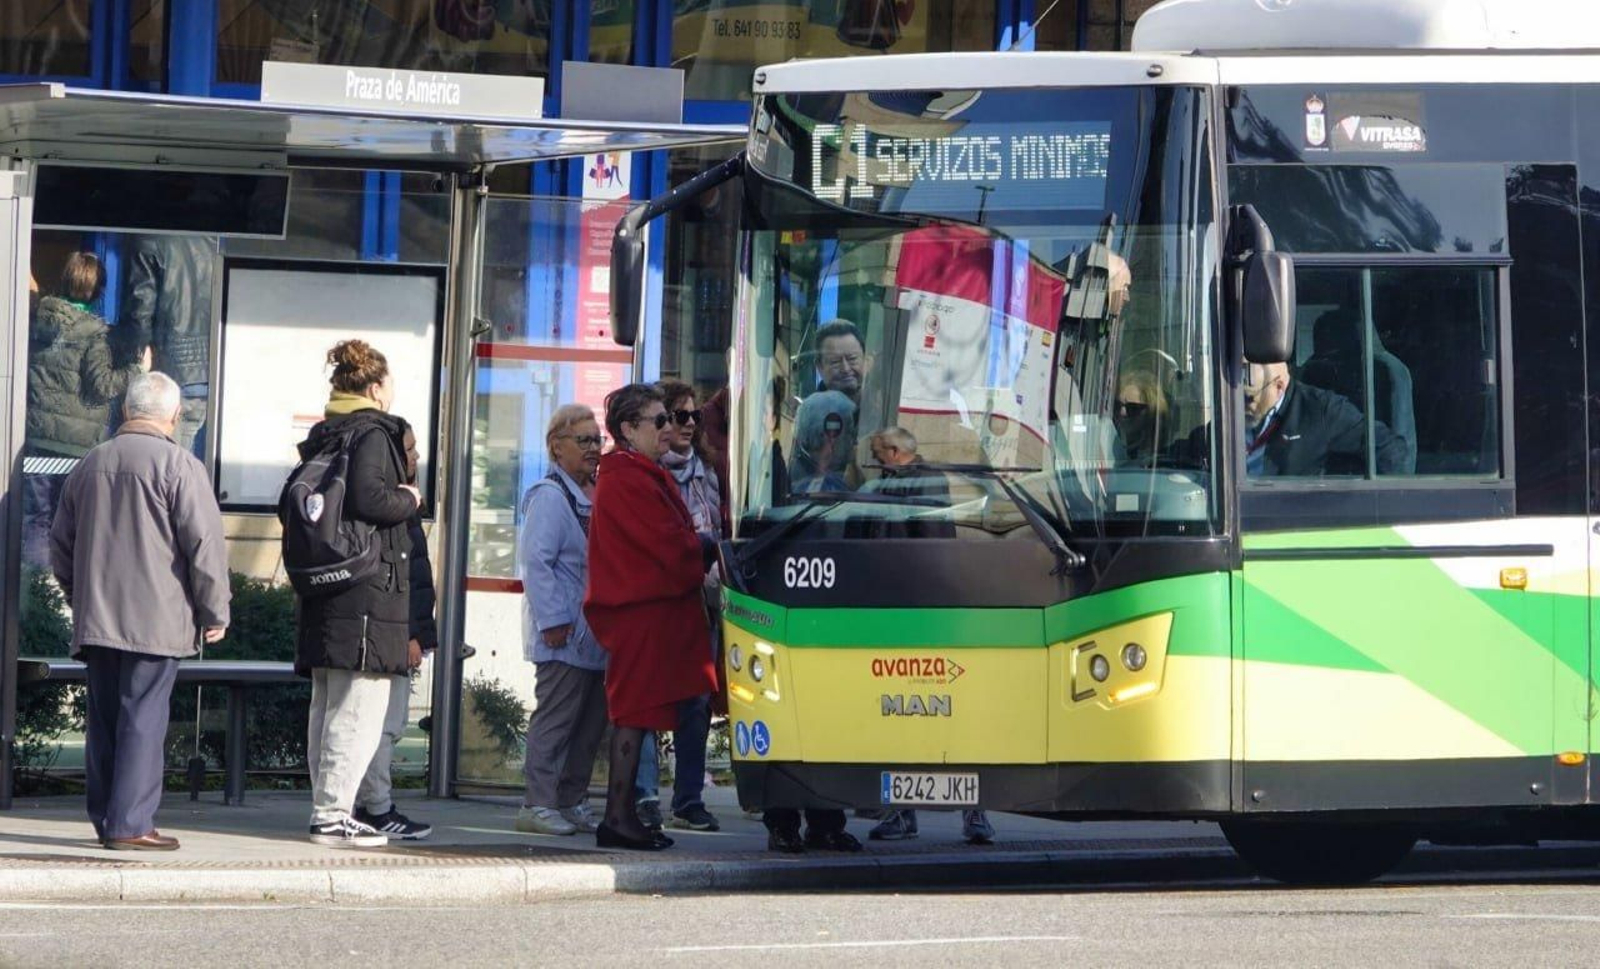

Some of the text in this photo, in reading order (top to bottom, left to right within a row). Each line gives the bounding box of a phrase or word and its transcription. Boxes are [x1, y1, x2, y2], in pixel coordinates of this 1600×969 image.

[712, 19, 801, 39] Tel. 641 90 93 83
[345, 69, 461, 105] Praza de América
[1361, 126, 1421, 142] VITRASA
[811, 124, 874, 199] C1
[876, 137, 1002, 182] SERVIZOS
[1010, 134, 1111, 179] MINIMOS
[784, 556, 836, 588] 6209
[872, 658, 945, 677] avanza
[881, 695, 952, 717] MAN
[893, 776, 935, 800] 6242
[942, 776, 975, 801] JKH
